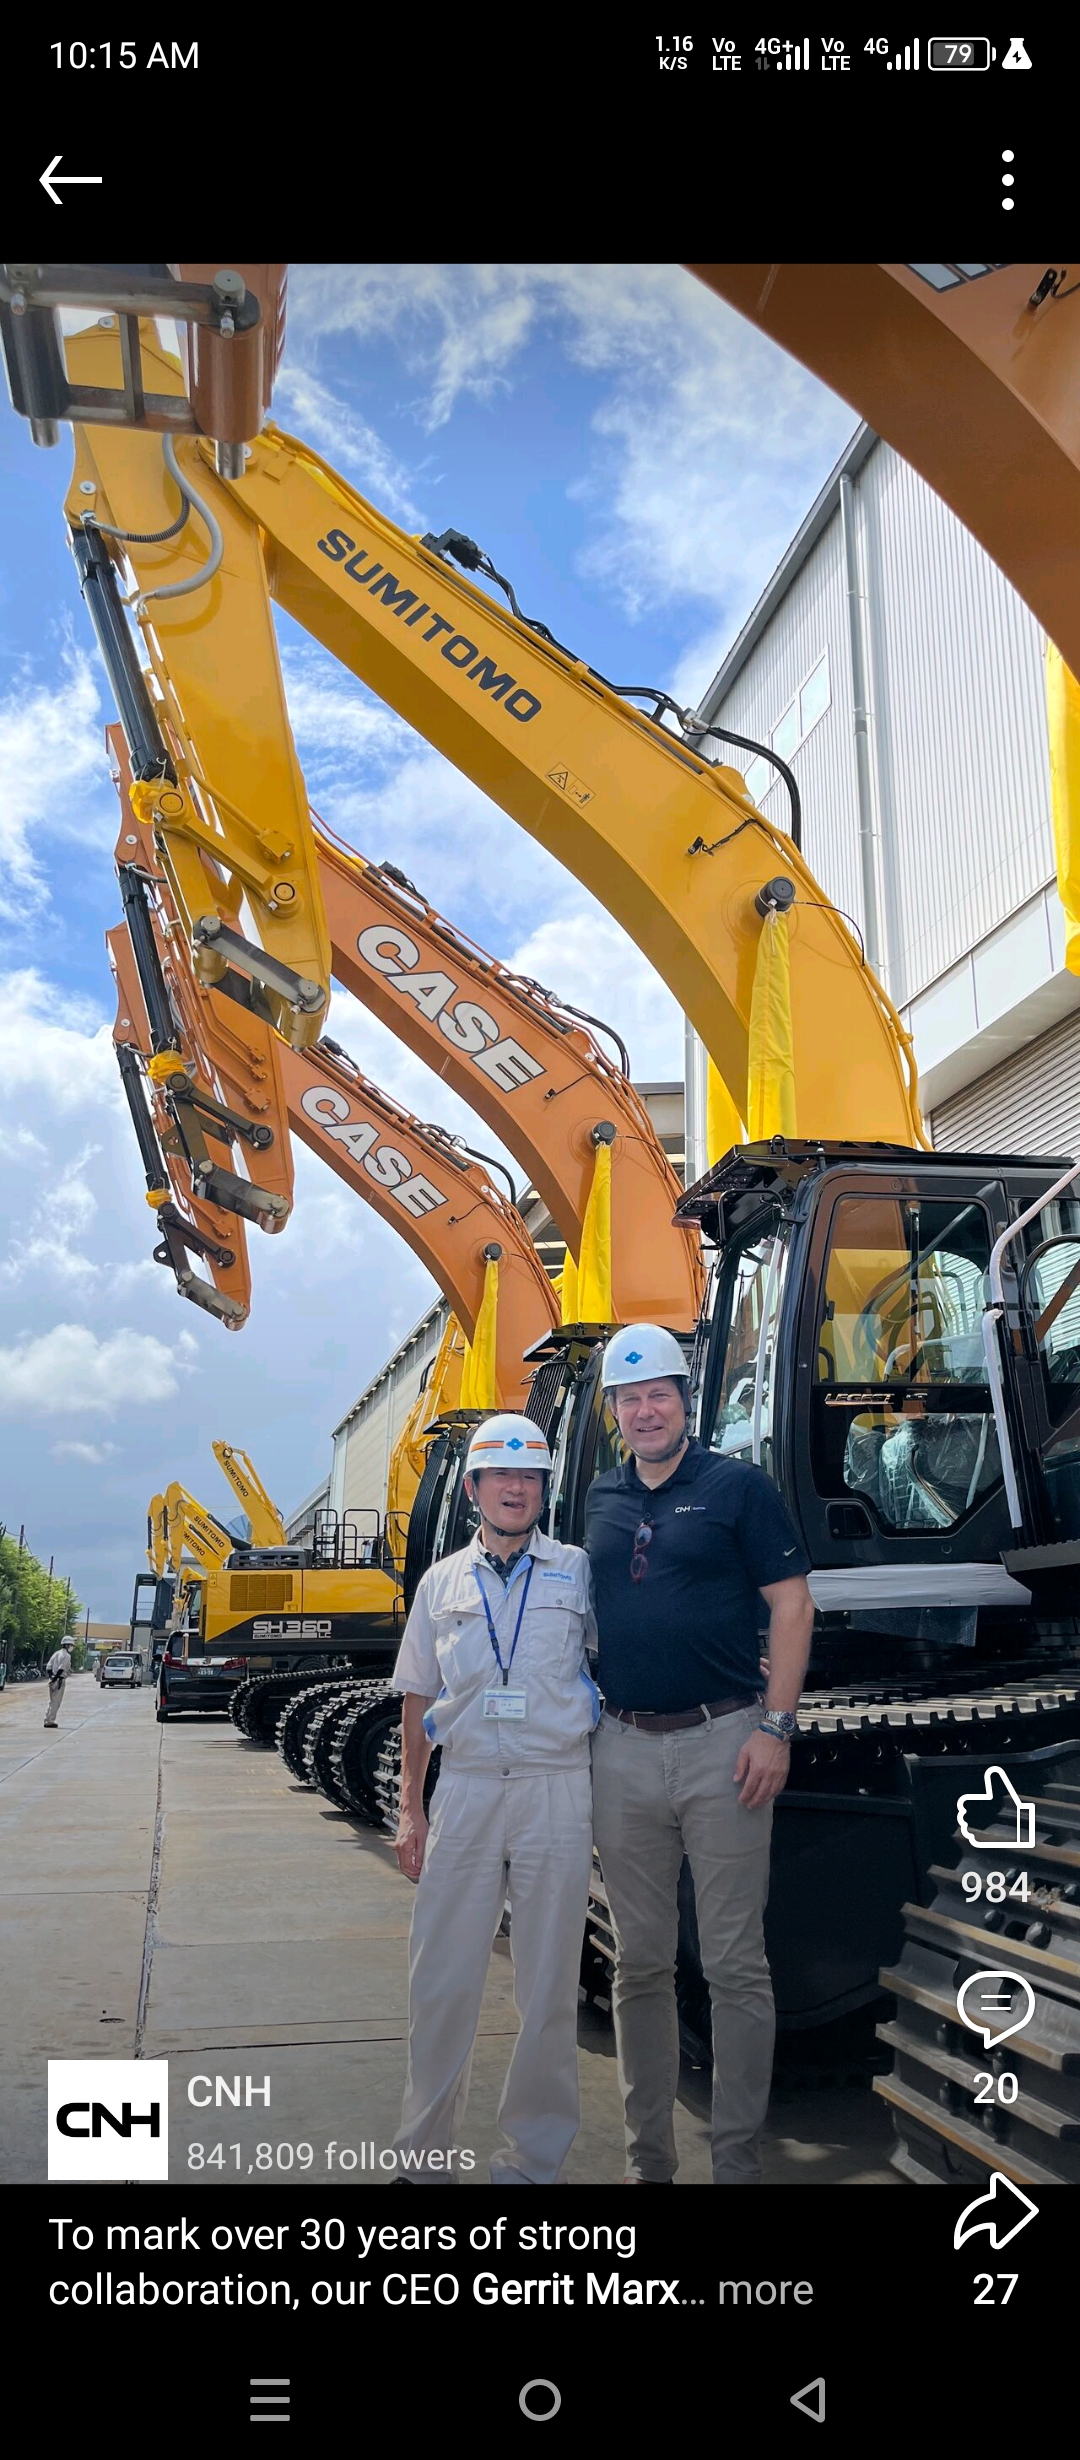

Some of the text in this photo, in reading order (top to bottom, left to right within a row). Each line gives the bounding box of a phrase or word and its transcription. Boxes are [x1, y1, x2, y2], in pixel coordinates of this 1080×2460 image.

[317, 528, 542, 723] SUMITOMO
[357, 924, 547, 1094] CASE
[301, 1085, 449, 1219] CASE
[224, 1460, 249, 1497] SUMITOMO
[675, 1505, 691, 1513] CNH
[183, 1531, 206, 1556] MITOMO
[194, 1515, 225, 1548] SUMITOMO
[543, 1572, 572, 1581] SUMITOMO
